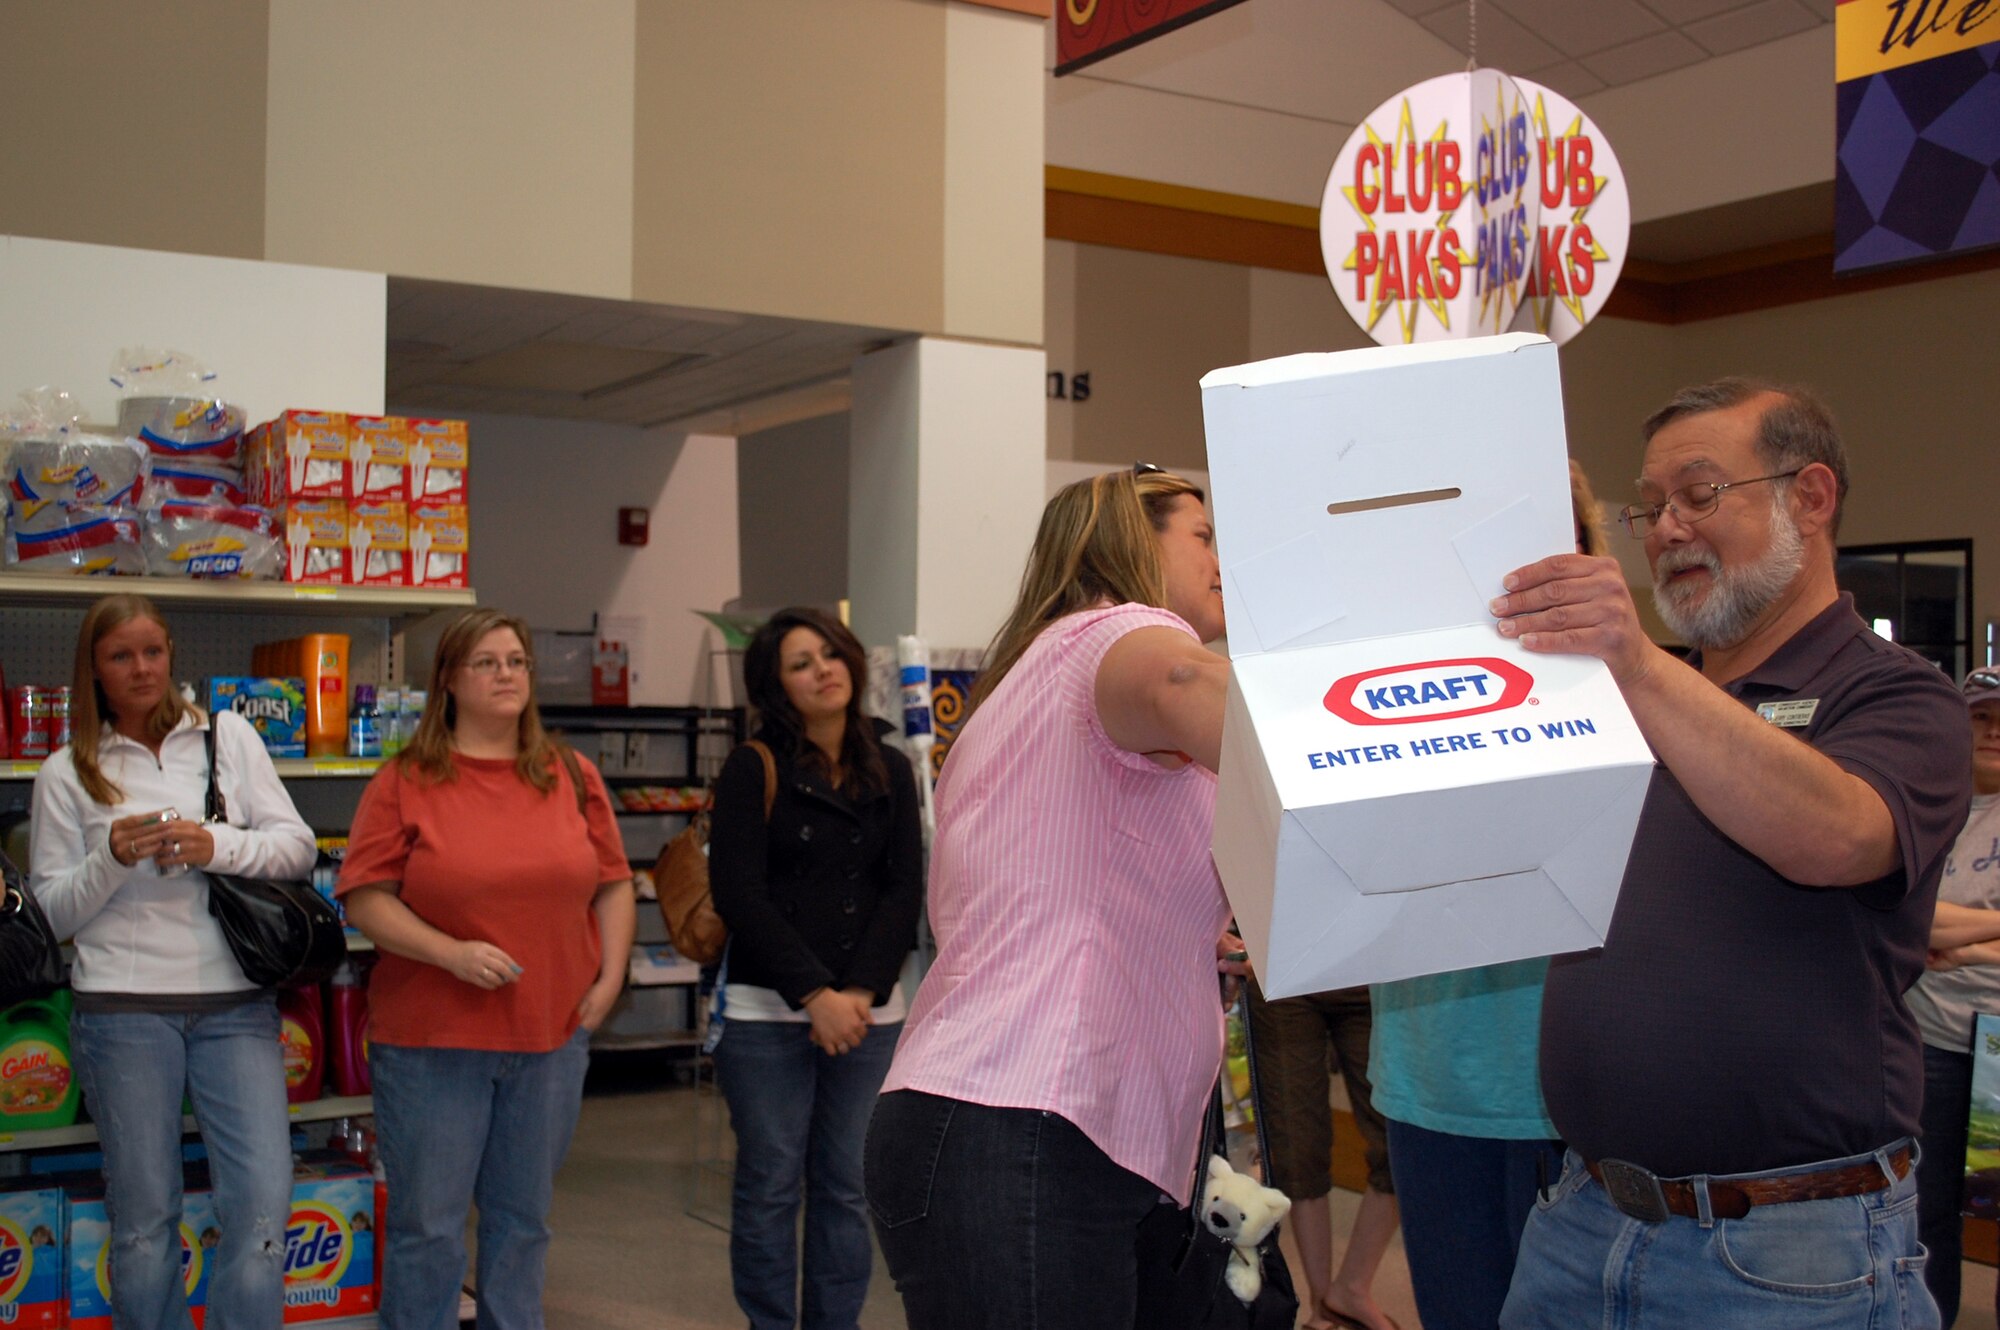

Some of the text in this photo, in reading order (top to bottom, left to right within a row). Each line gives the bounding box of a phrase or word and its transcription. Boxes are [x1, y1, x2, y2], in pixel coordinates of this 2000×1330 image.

[1355, 140, 1462, 214] CLUB
[1476, 112, 1529, 207] CLUB
[1357, 228, 1462, 301] PAKS
[1476, 202, 1528, 297] PAKS
[231, 693, 292, 726] Coast
[1364, 673, 1489, 711] KRAFT
[1307, 718, 1597, 770] ENTER HERE TO WIN
[2, 1051, 49, 1081] GAIN
[284, 1221, 342, 1273] Tide
[283, 1286, 340, 1306] owny
